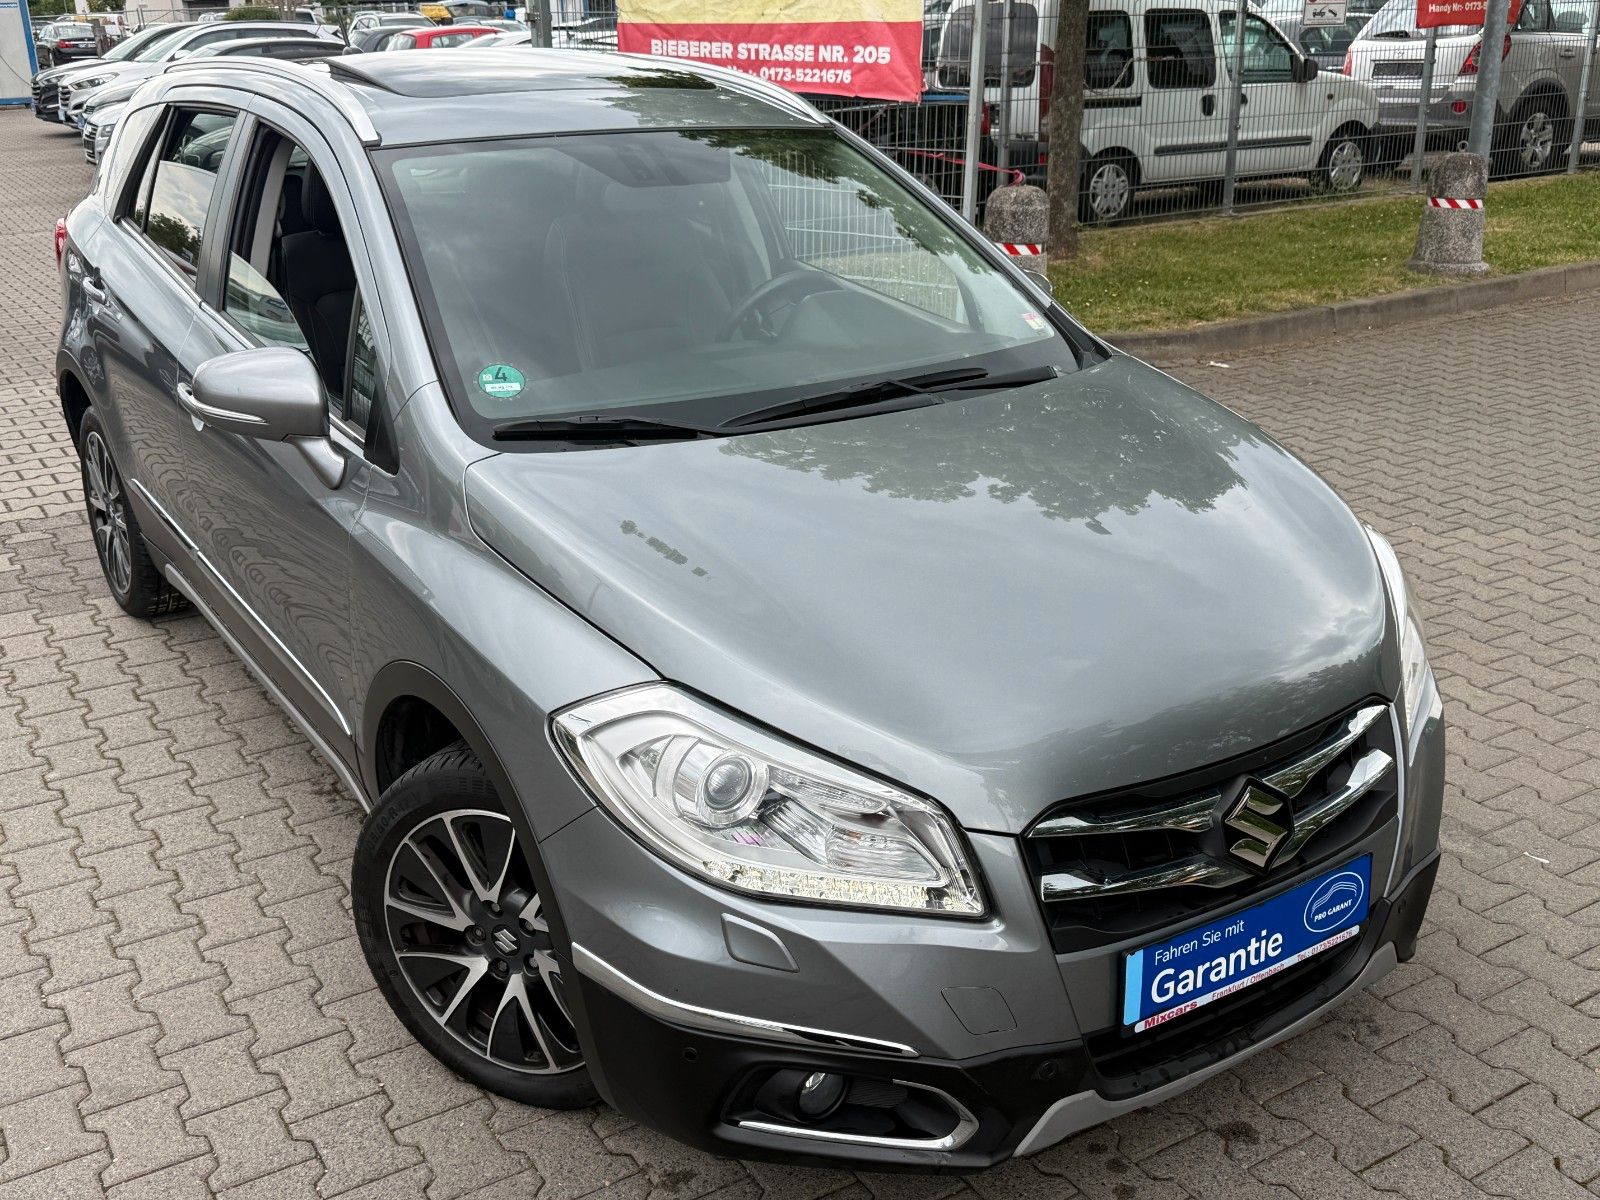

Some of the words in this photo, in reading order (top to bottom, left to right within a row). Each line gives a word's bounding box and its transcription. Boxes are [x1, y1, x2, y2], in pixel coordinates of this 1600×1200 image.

[1429, 3, 1451, 13] Handy
[737, 43, 815, 62] STRASSE
[818, 44, 849, 63] NR.
[853, 46, 891, 65] 205
[759, 67, 852, 84] 0173-5221676
[495, 366, 508, 381] 4
[1313, 911, 1327, 923] PRO
[1327, 898, 1353, 916] GARANT
[1154, 938, 1198, 966] Fahren
[1202, 931, 1221, 948] Sie
[1224, 919, 1245, 939] mit
[1151, 929, 1283, 1004] Garantie
[1144, 1001, 1198, 1029] Mixcars
[1211, 981, 1245, 1001] Frankfurt
